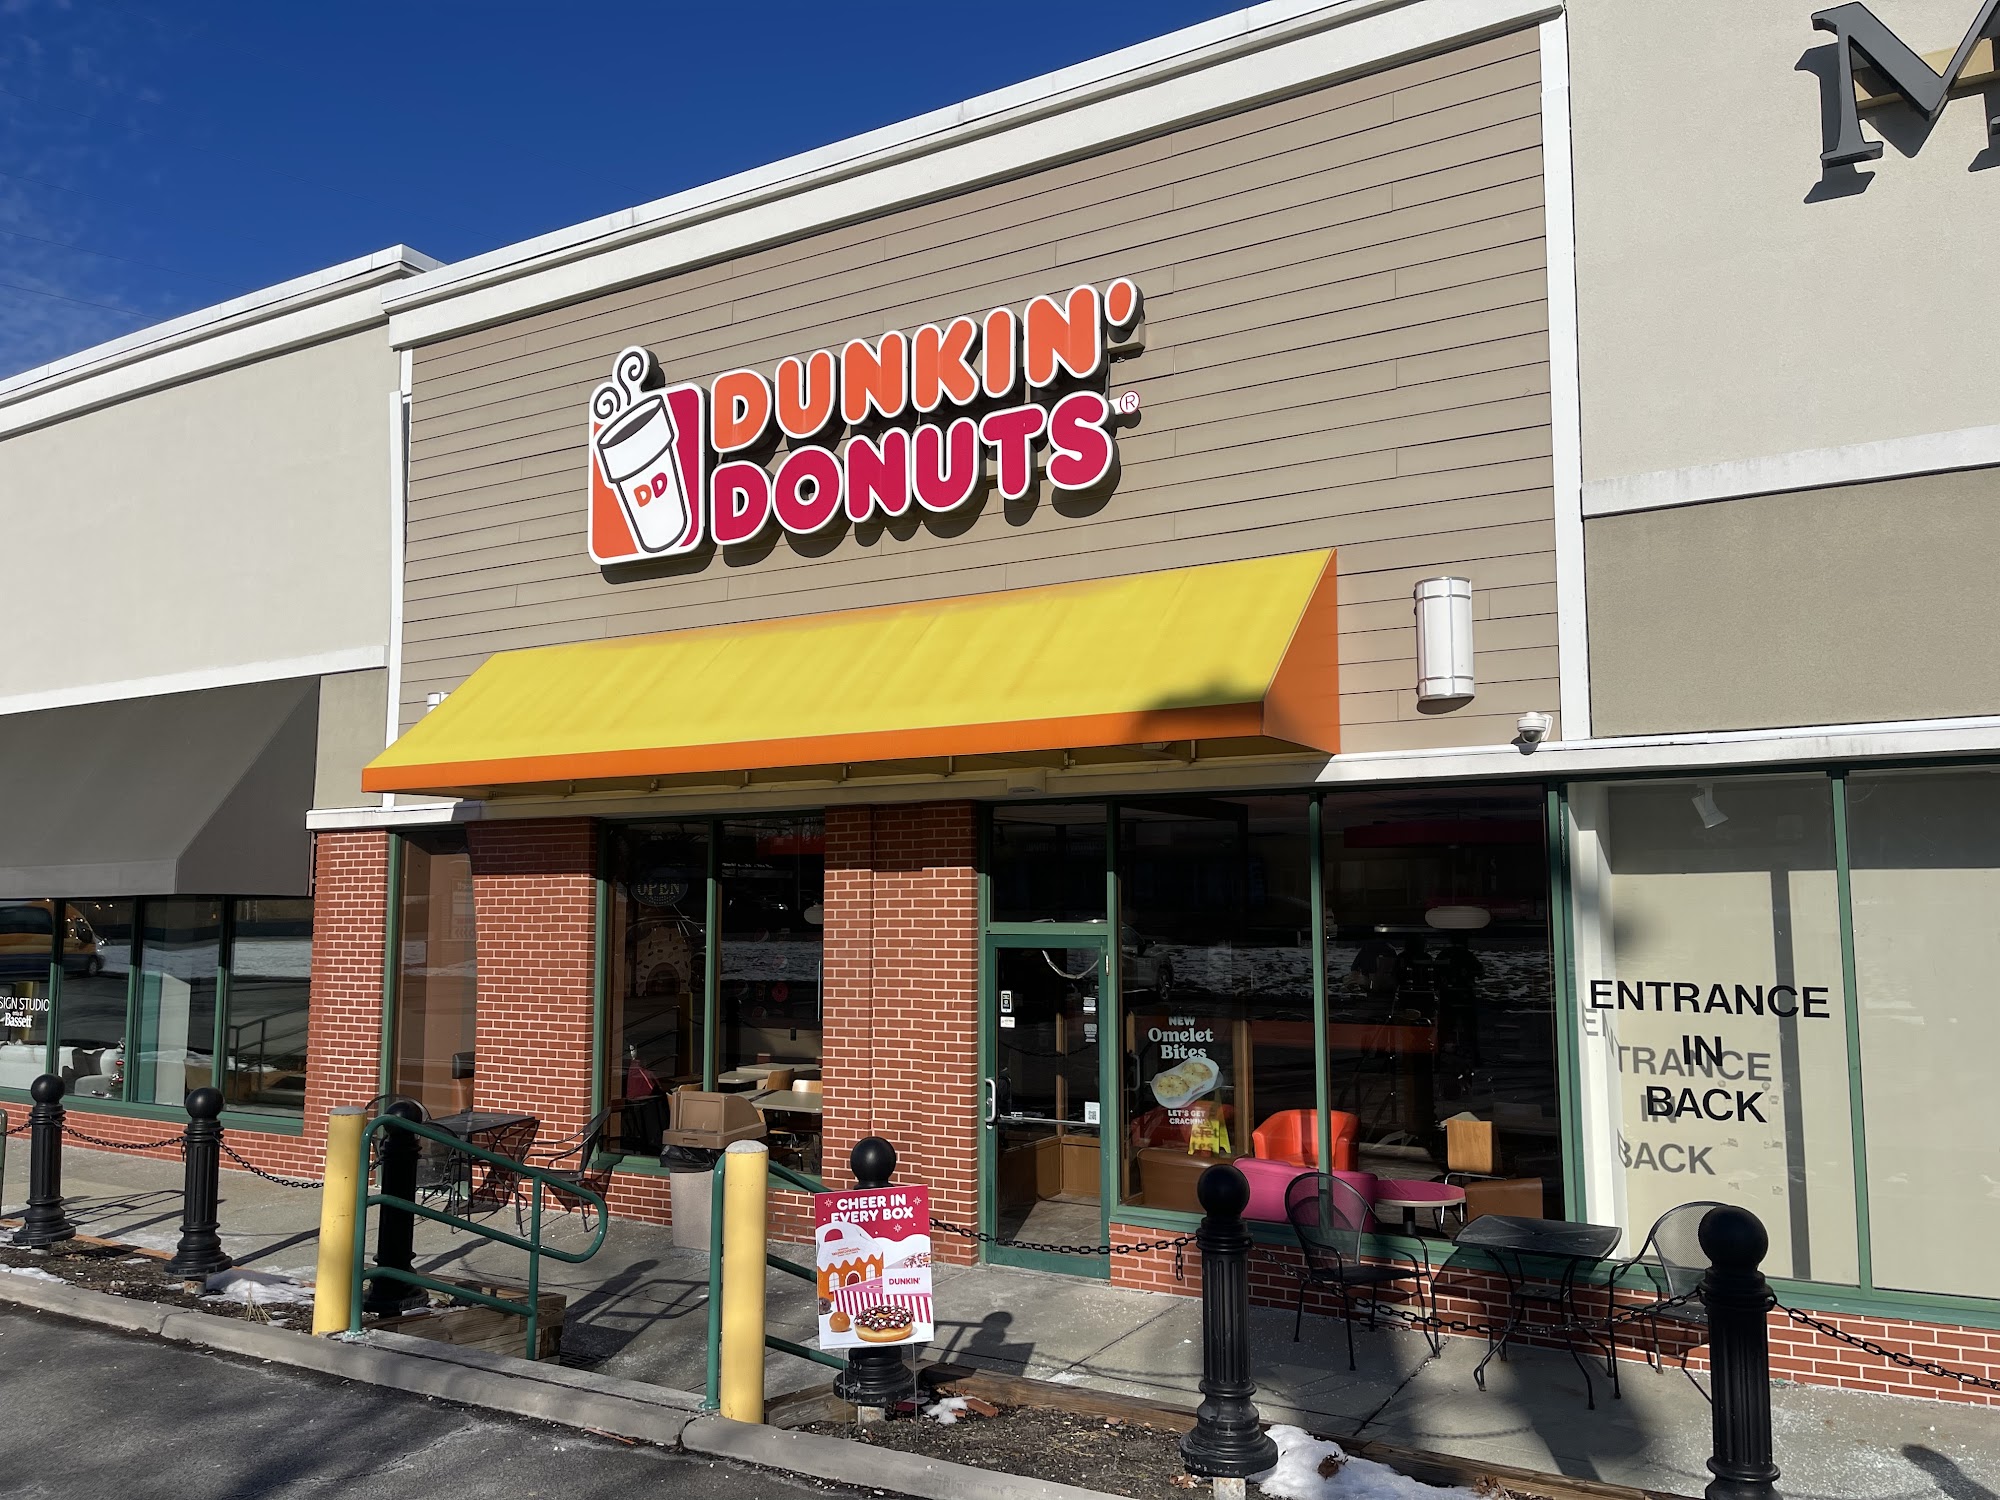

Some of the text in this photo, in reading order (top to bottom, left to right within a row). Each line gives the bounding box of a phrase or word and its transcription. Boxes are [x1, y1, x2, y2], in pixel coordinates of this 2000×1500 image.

[711, 278, 1138, 453] DUNKIN'
[710, 391, 1115, 545] DONUTS
[634, 472, 668, 508] DD
[637, 882, 680, 896] OPEN
[19, 998, 50, 1011] STUDIO
[1590, 980, 1830, 1018] ENTRANCE
[5, 1012, 33, 1028] Bassett
[1168, 1016, 1196, 1026] NEW
[1148, 1027, 1214, 1042] Omelet
[1160, 1044, 1207, 1059] Bites
[1682, 1034, 1723, 1067] IN
[1646, 1085, 1768, 1123] BACK
[1168, 1109, 1189, 1117] LET'S
[1169, 1117, 1206, 1125] CRACKIN'
[836, 1193, 907, 1211] CHEER IN
[830, 1206, 914, 1223] EVERY BOX
[888, 1277, 921, 1286] DUNKIN'
